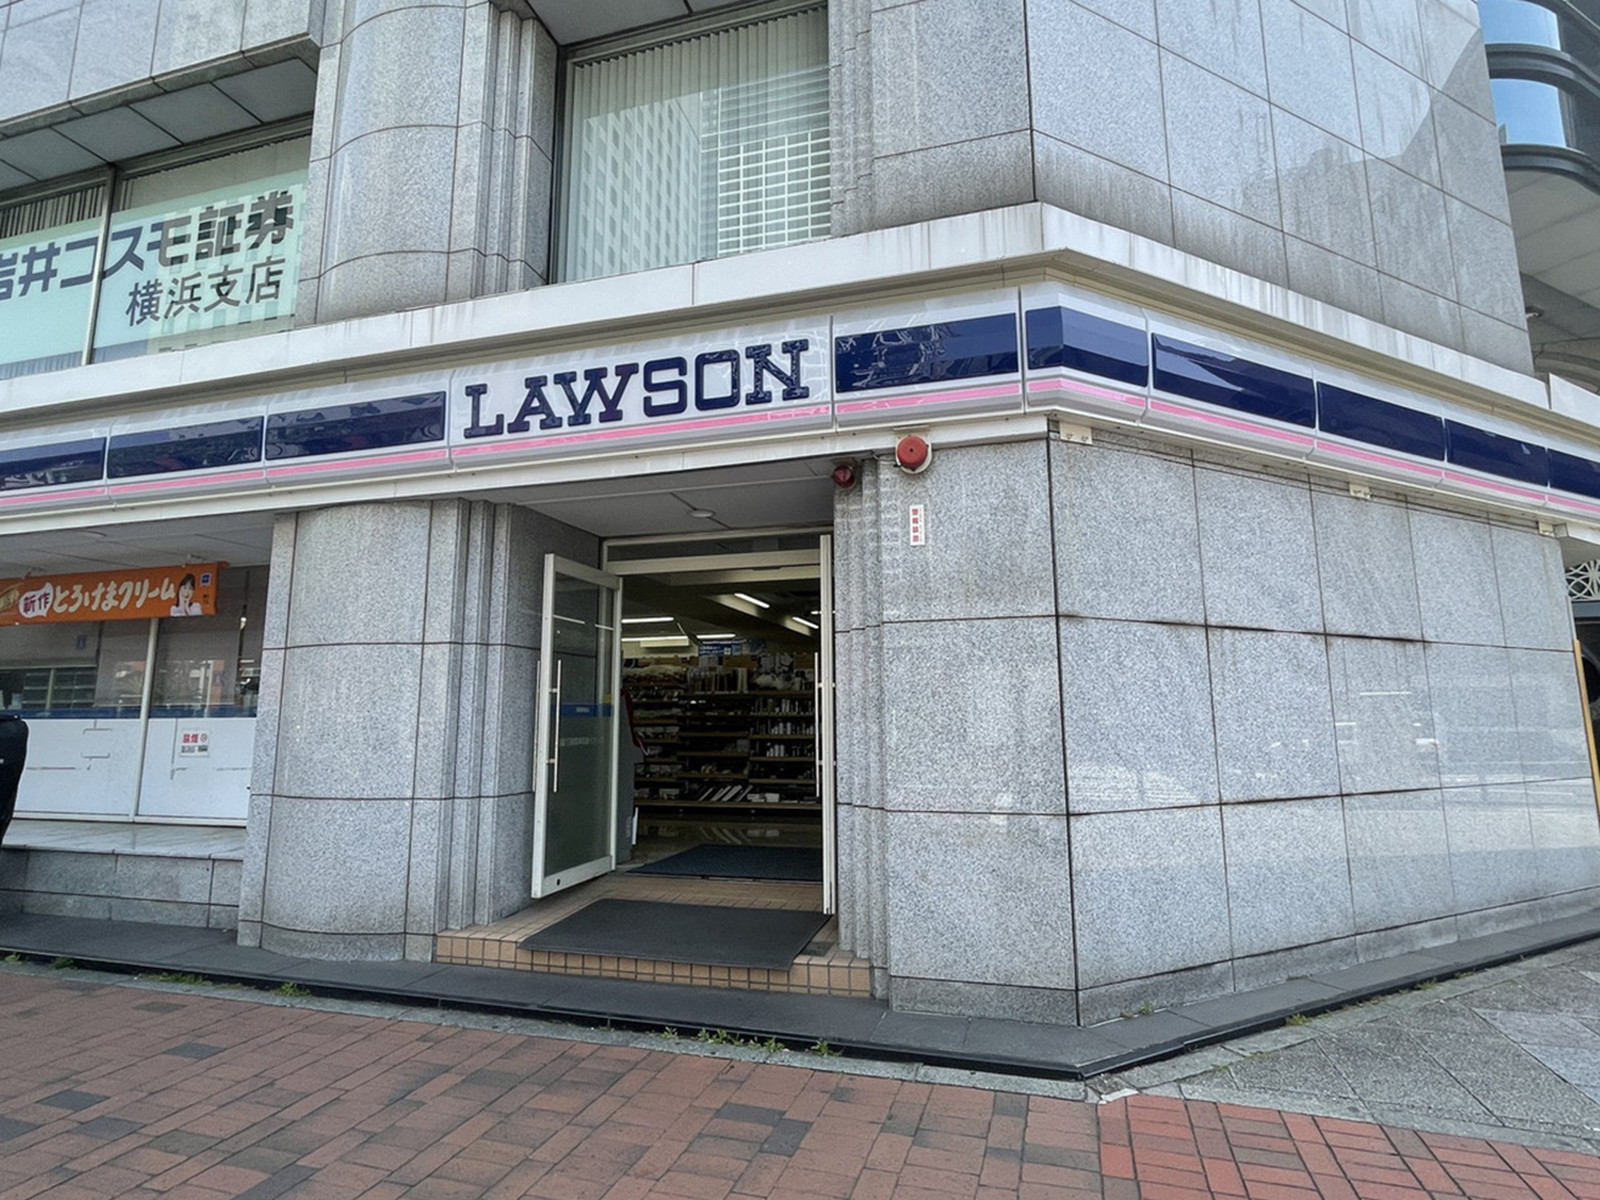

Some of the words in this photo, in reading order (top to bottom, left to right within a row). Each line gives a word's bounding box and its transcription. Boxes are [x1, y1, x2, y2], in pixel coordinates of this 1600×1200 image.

[126, 255, 286, 327] 横浜支店
[463, 338, 810, 439] LAWSON
[23, 592, 50, 614] 新作
